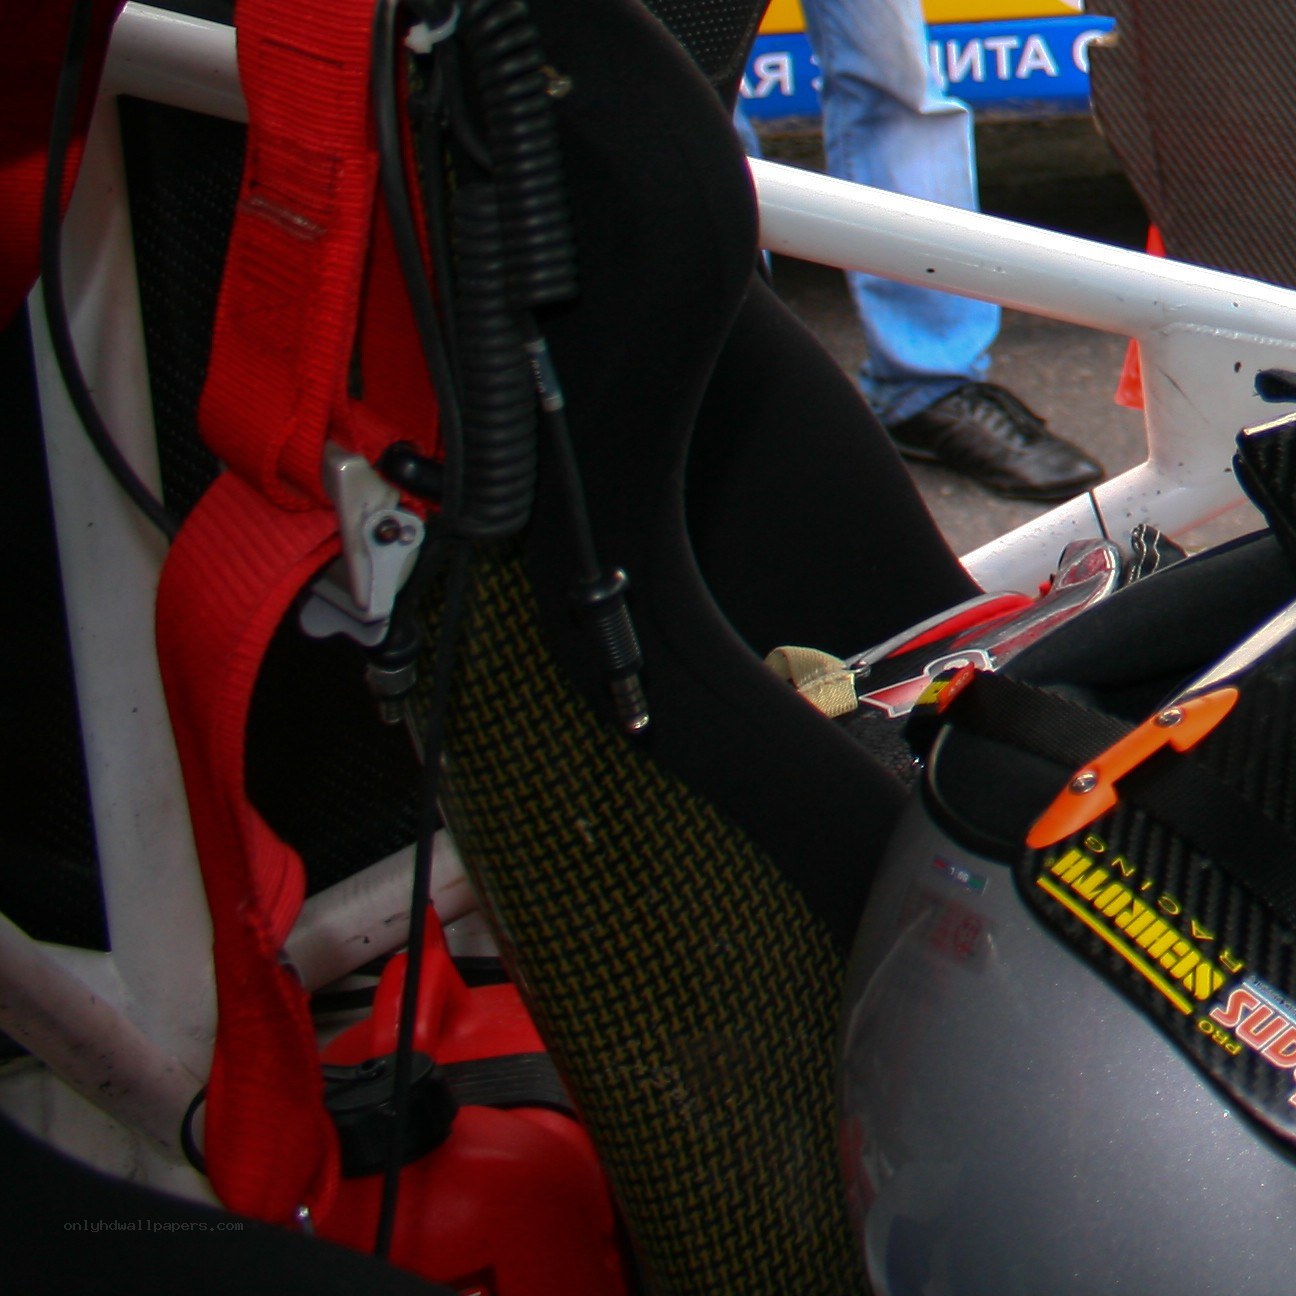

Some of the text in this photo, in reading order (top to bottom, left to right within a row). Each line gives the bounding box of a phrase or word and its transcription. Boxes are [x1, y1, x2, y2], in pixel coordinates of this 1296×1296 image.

[1050, 849, 1226, 1001] SCHROTH
[1084, 836, 1244, 974] RACING
[1198, 1018, 1243, 1056] PRO
